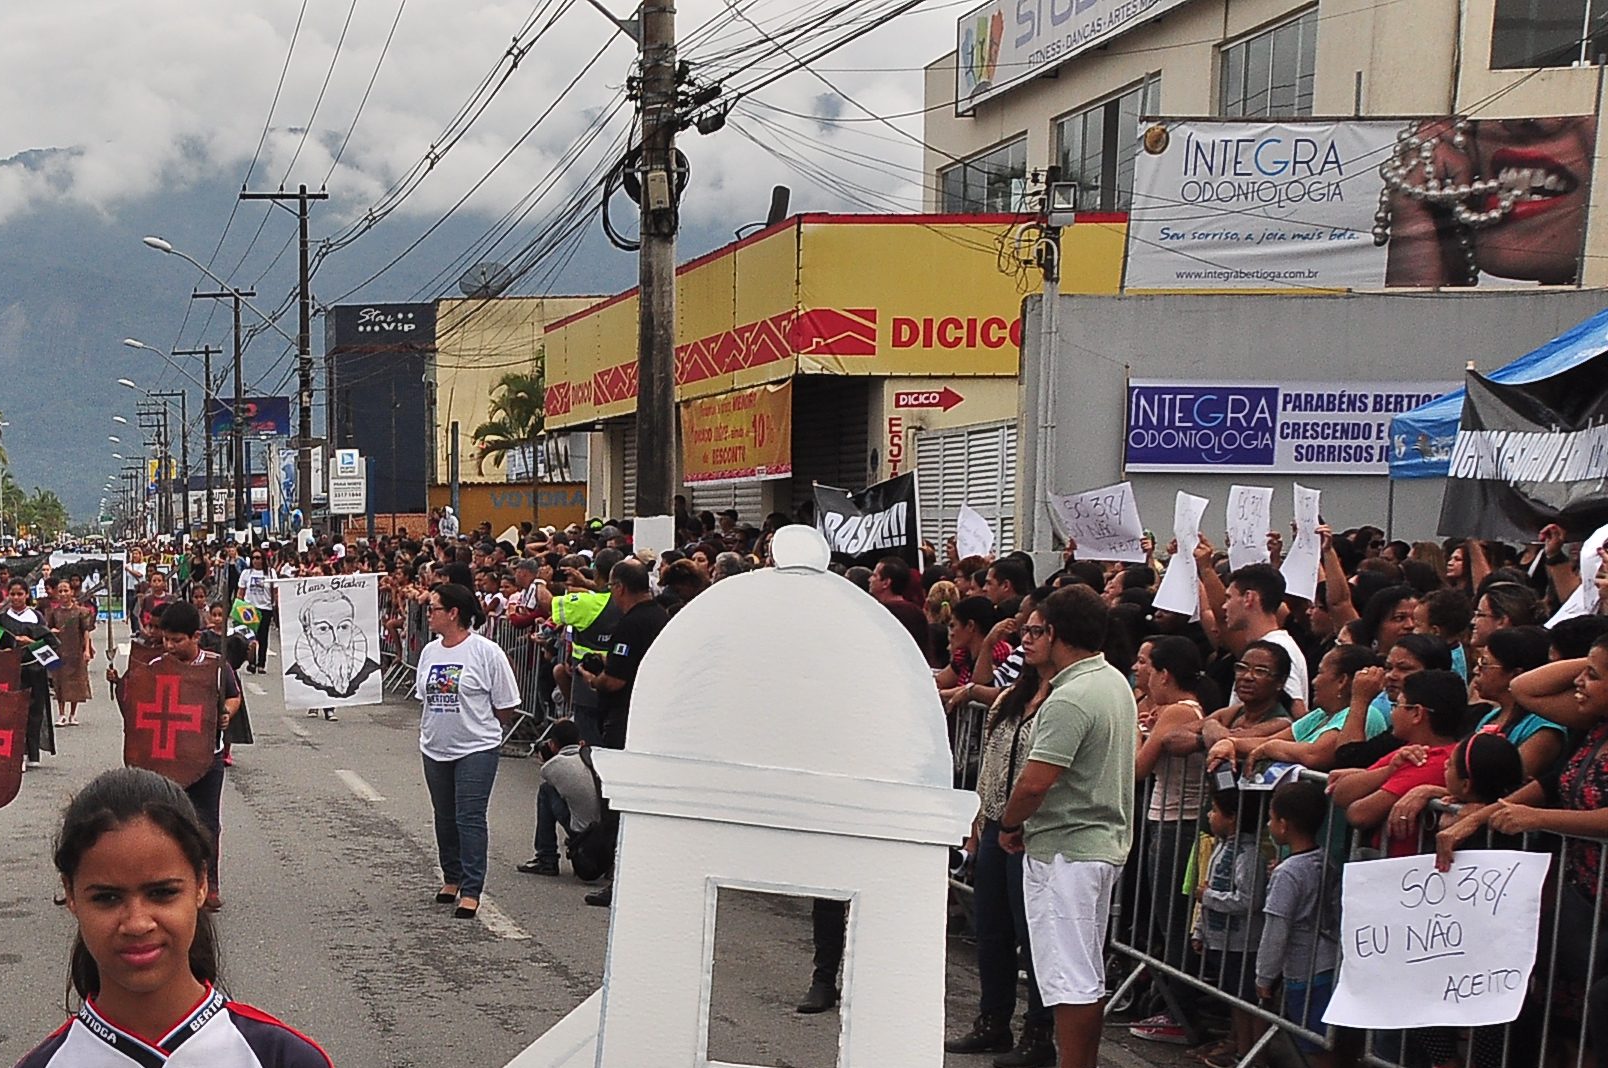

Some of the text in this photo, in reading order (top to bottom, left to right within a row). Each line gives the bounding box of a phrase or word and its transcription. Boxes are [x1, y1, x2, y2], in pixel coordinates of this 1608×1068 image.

[1181, 180, 1344, 208] ODONTOLOGIA
[1159, 227, 1185, 241] Seu
[1245, 233, 1254, 241] a
[1256, 228, 1287, 244] joia
[1291, 228, 1323, 241] mais
[1176, 268, 1319, 281] www.integrabertioga.com.br
[899, 393, 940, 406] DICICO
[1281, 389, 1368, 413] PARABÉNS
[1129, 429, 1273, 454] ODONTOLOGIA
[1279, 421, 1385, 441] CRESCENDO E
[1294, 443, 1374, 463] SORRISOS
[296, 579, 326, 596] Hans
[1456, 862, 1521, 916] 3,8%
[1355, 913, 1463, 959] EU NÃO
[1443, 968, 1522, 1005] ACEITO
